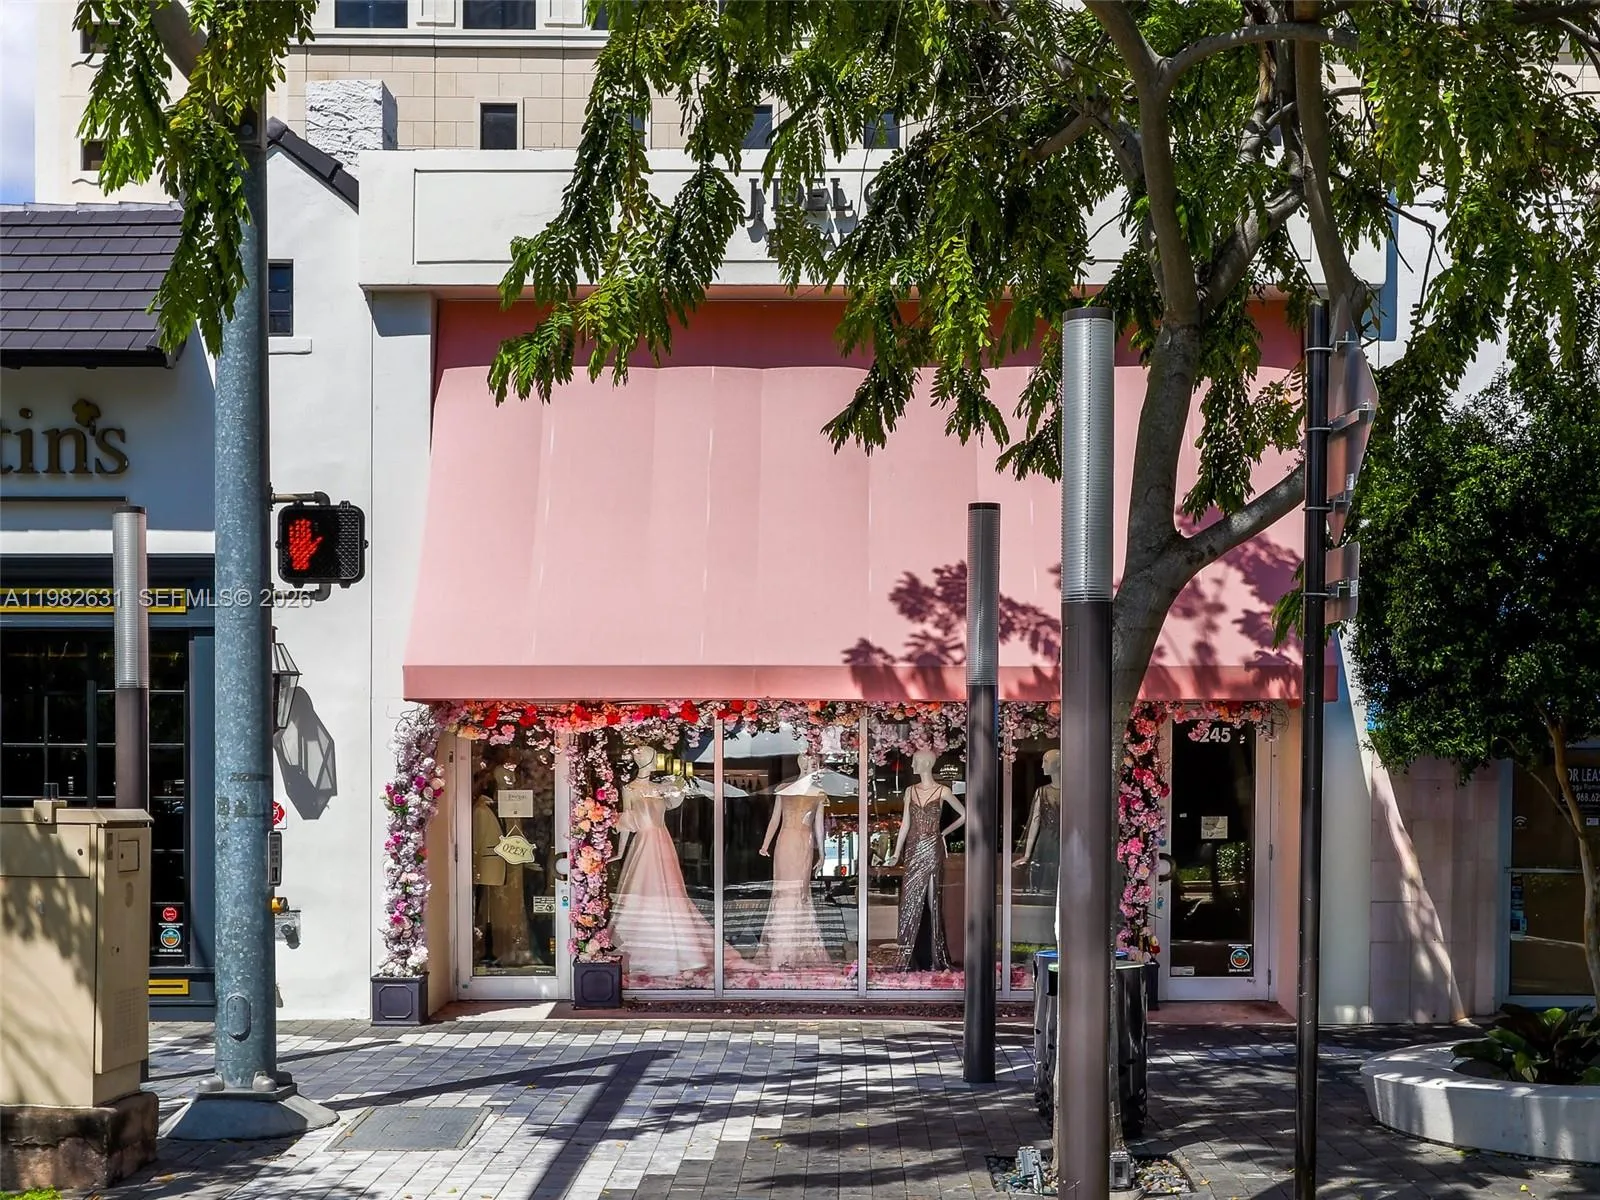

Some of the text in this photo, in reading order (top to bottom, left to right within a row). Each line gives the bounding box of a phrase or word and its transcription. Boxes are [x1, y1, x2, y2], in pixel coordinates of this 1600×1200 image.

[1200, 727, 1231, 743] 245
[1567, 768, 1580, 782] OR
[502, 843, 528, 856] OPEN
